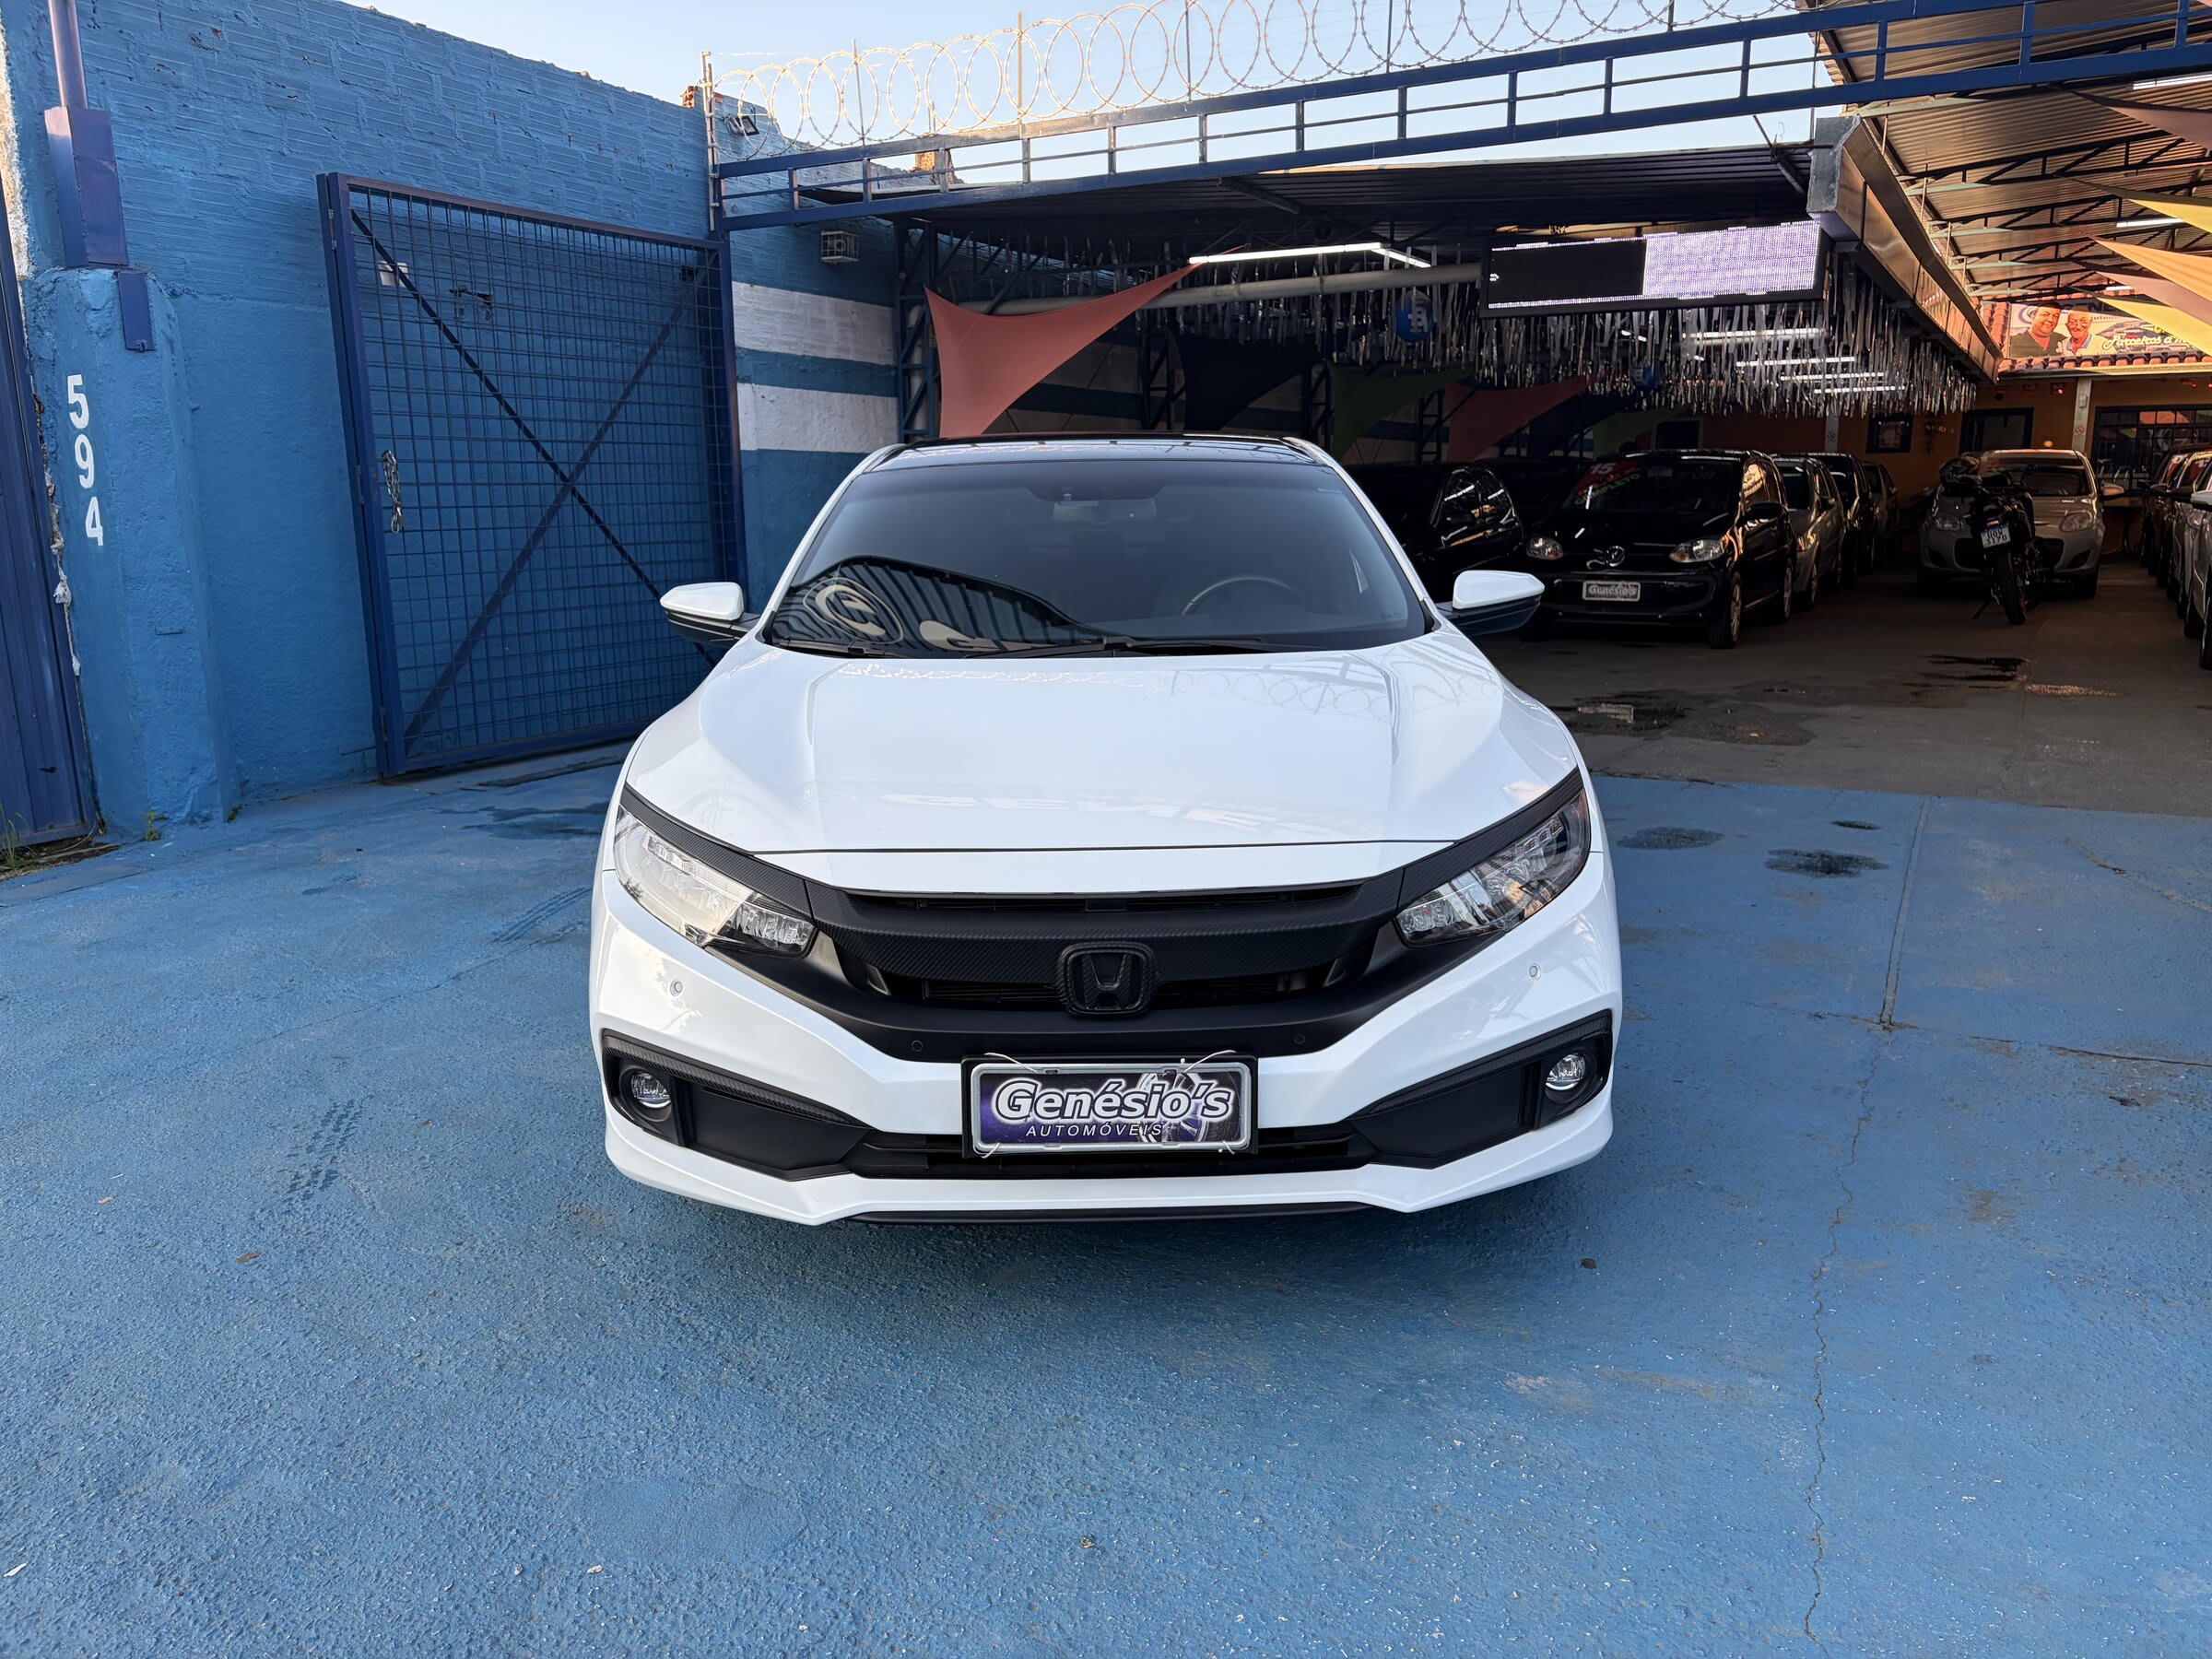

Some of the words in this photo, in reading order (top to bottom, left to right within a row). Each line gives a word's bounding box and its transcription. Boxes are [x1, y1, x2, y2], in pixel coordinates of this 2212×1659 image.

[66, 373, 104, 547] 594
[994, 1078, 1231, 1122] Genésio's
[1025, 1121, 1163, 1136] AUTOMÓVEIS
